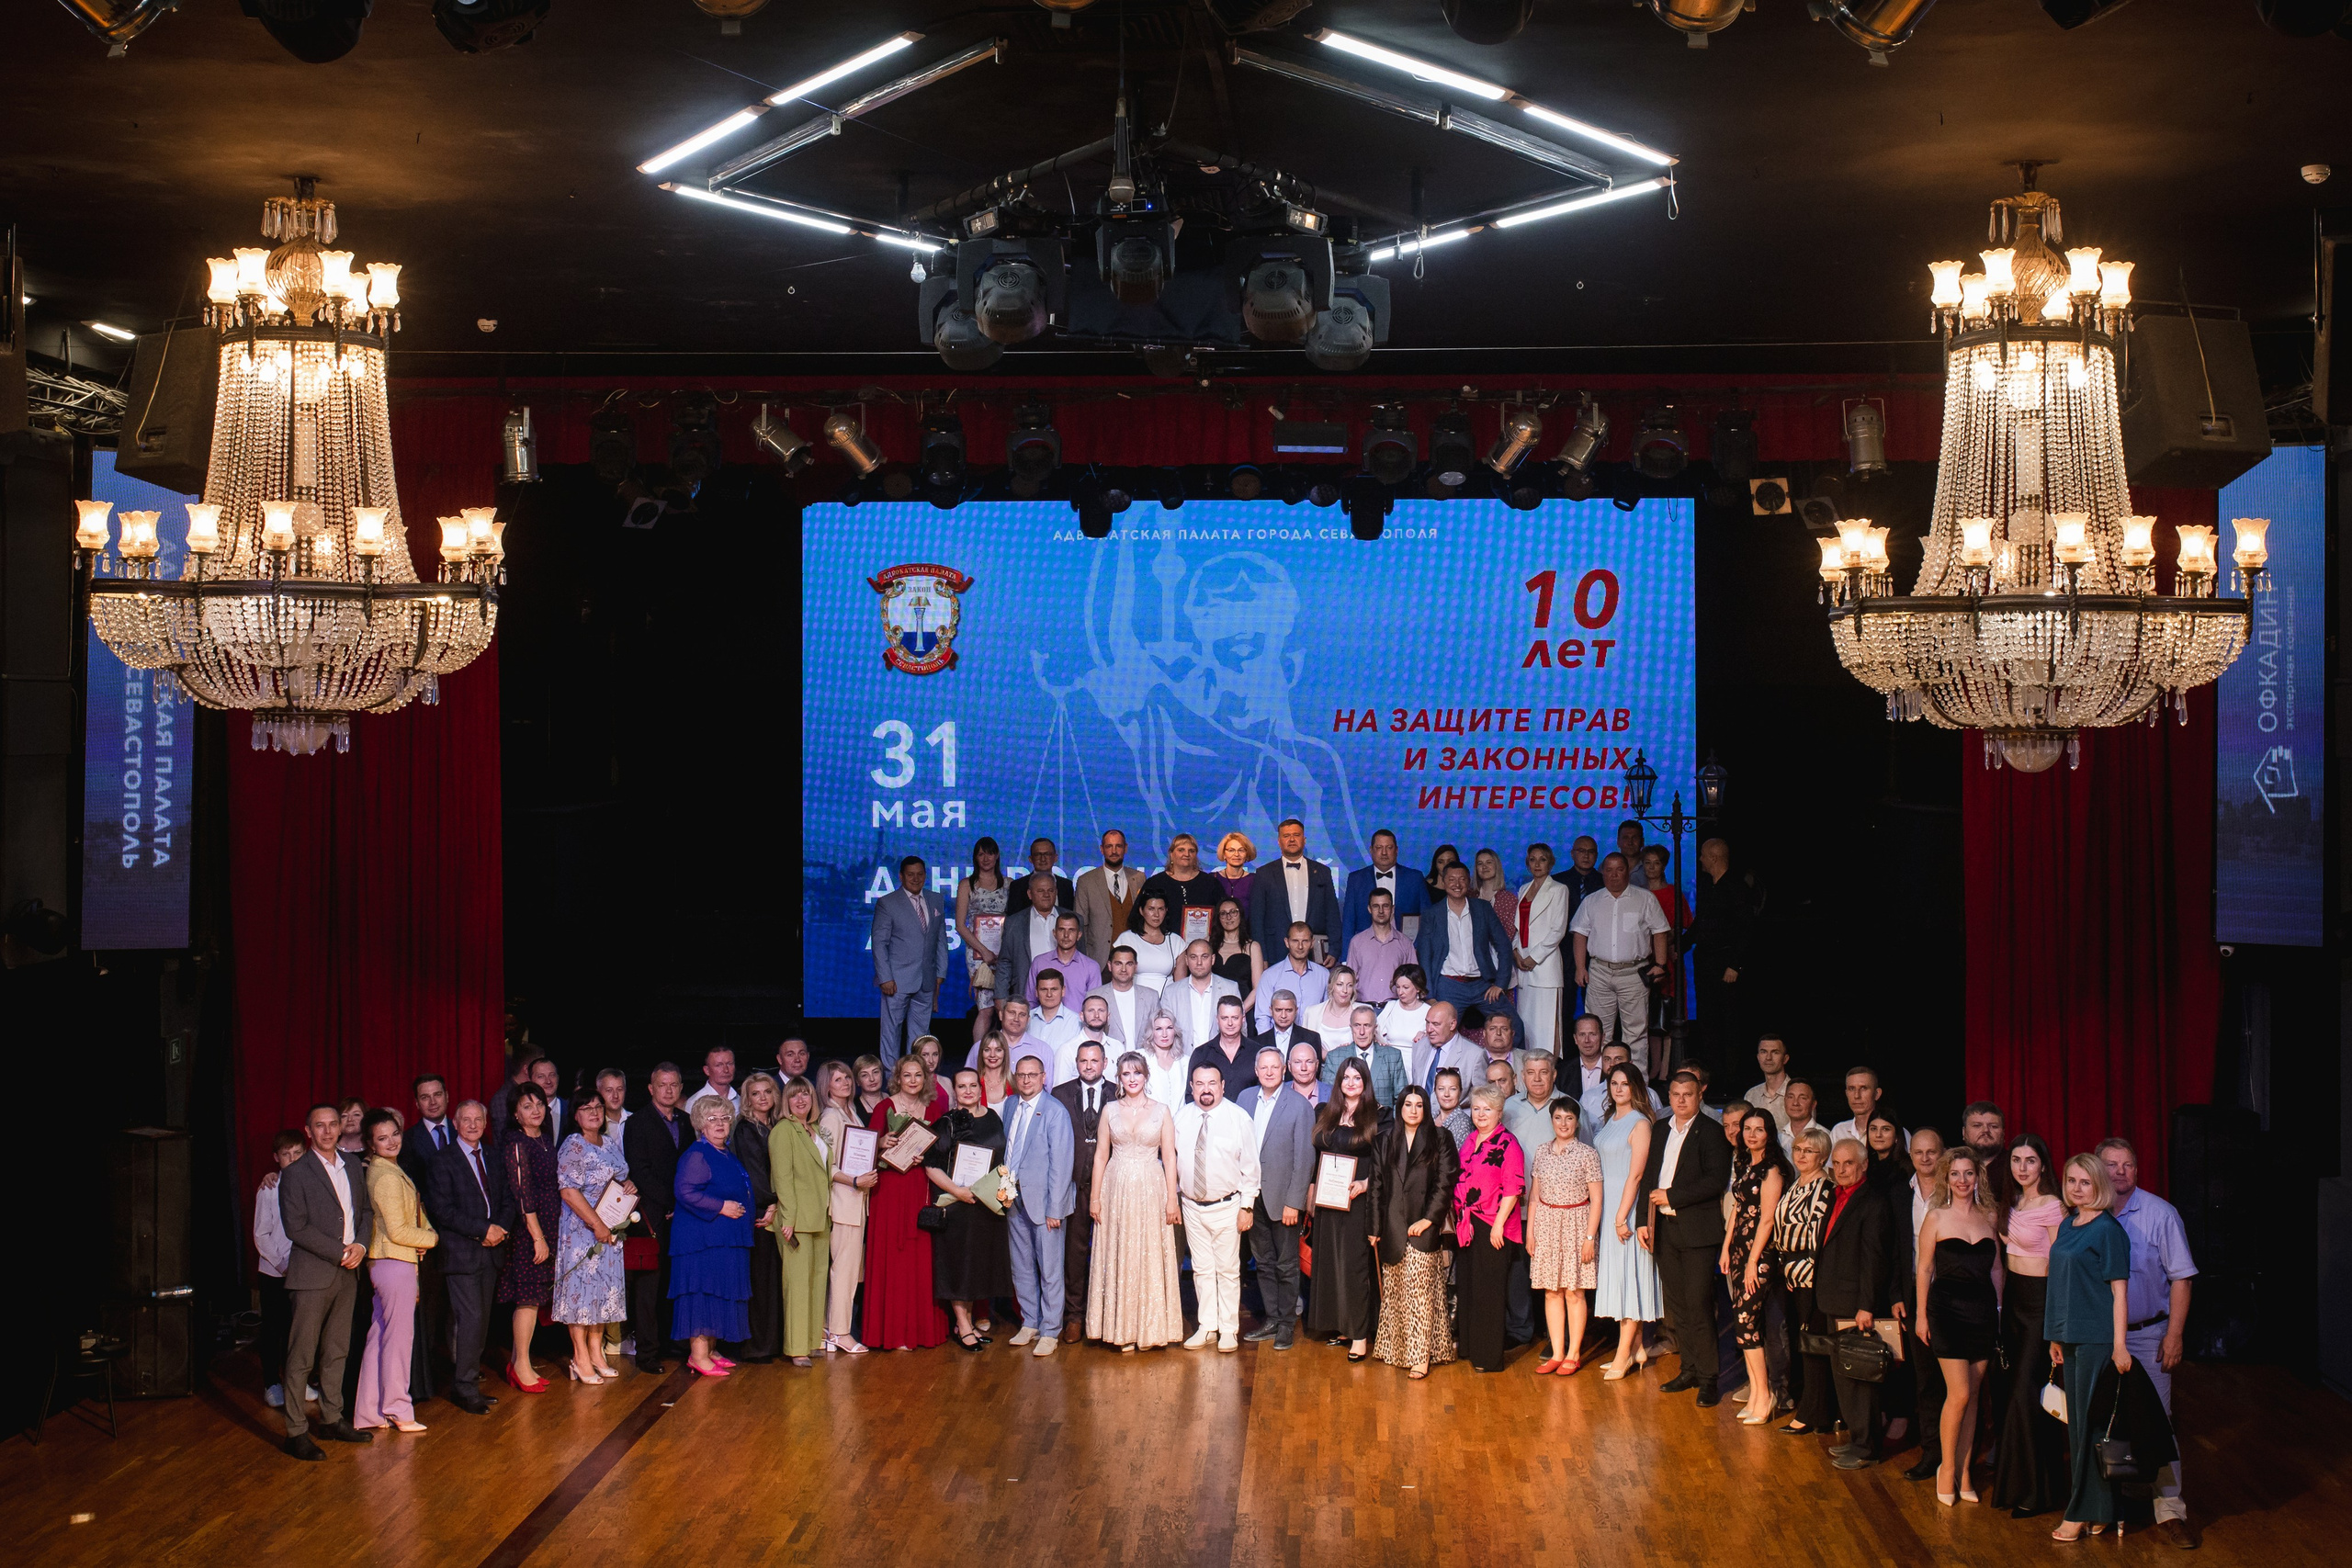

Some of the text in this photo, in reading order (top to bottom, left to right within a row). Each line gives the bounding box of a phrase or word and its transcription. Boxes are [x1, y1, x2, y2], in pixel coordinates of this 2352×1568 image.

[1053, 528, 1438, 541] АДВАТСКАЯ ПАЛАТА ГОРОДА СЕВОПОЛЯ
[883, 567, 956, 580] АДВОКАТСКАЯ ПАЛАТА
[1525, 569, 1620, 629] 10
[1521, 639, 1616, 669] лет
[1333, 708, 1631, 736] НА ЗАЩИТЕ ПРАВ
[870, 719, 956, 788] 31
[1403, 747, 1633, 771] И ЗАКОННЫХ
[1418, 785, 1632, 810] ИНТЕРЕСОВ!
[153, 756, 173, 868] ПАЛАТА
[873, 800, 966, 828] мая
